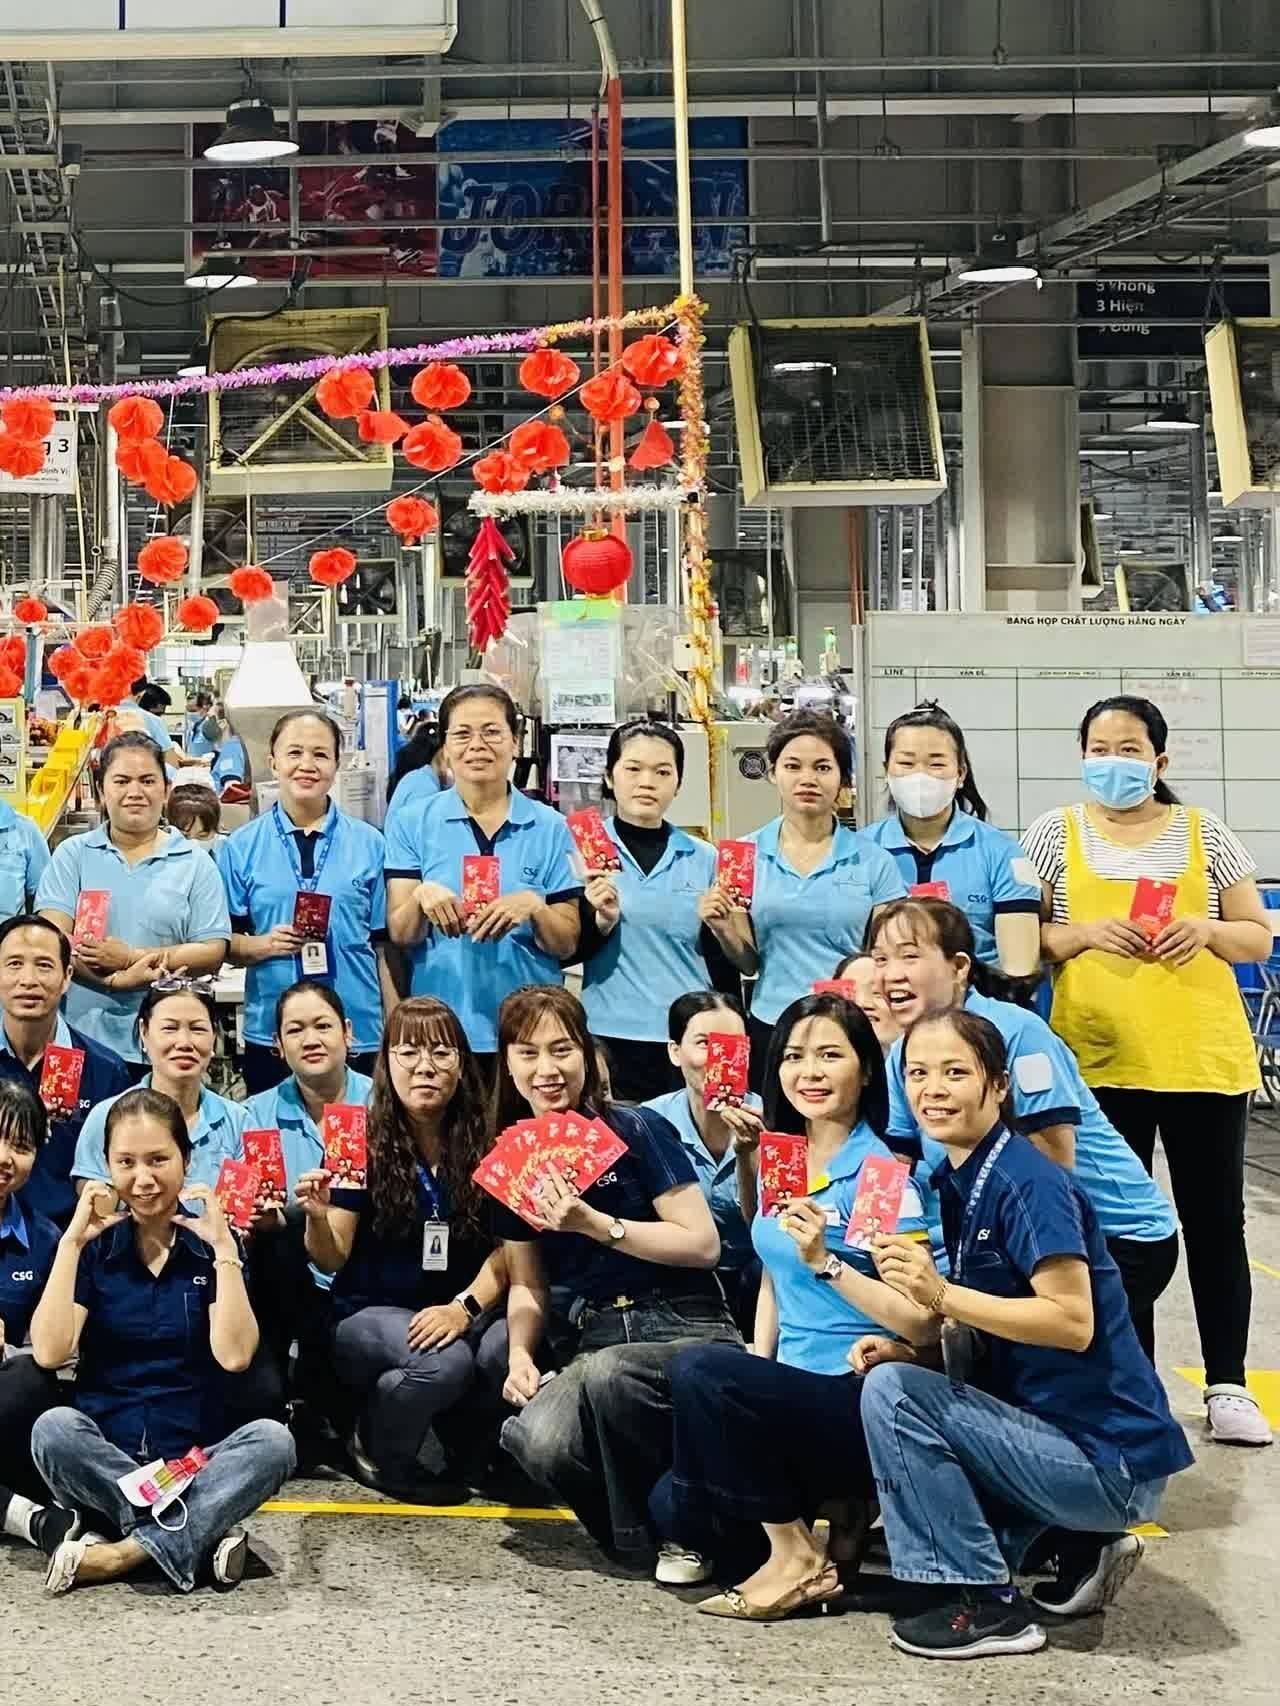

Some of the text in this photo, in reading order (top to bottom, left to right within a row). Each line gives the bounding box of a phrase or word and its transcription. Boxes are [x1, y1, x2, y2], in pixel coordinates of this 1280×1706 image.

[1096, 299, 1106, 312] 3
[58, 438, 69, 453] 3
[596, 1171, 617, 1187] CSG
[11, 1271, 33, 1281] CSG
[192, 1276, 208, 1286] CS
